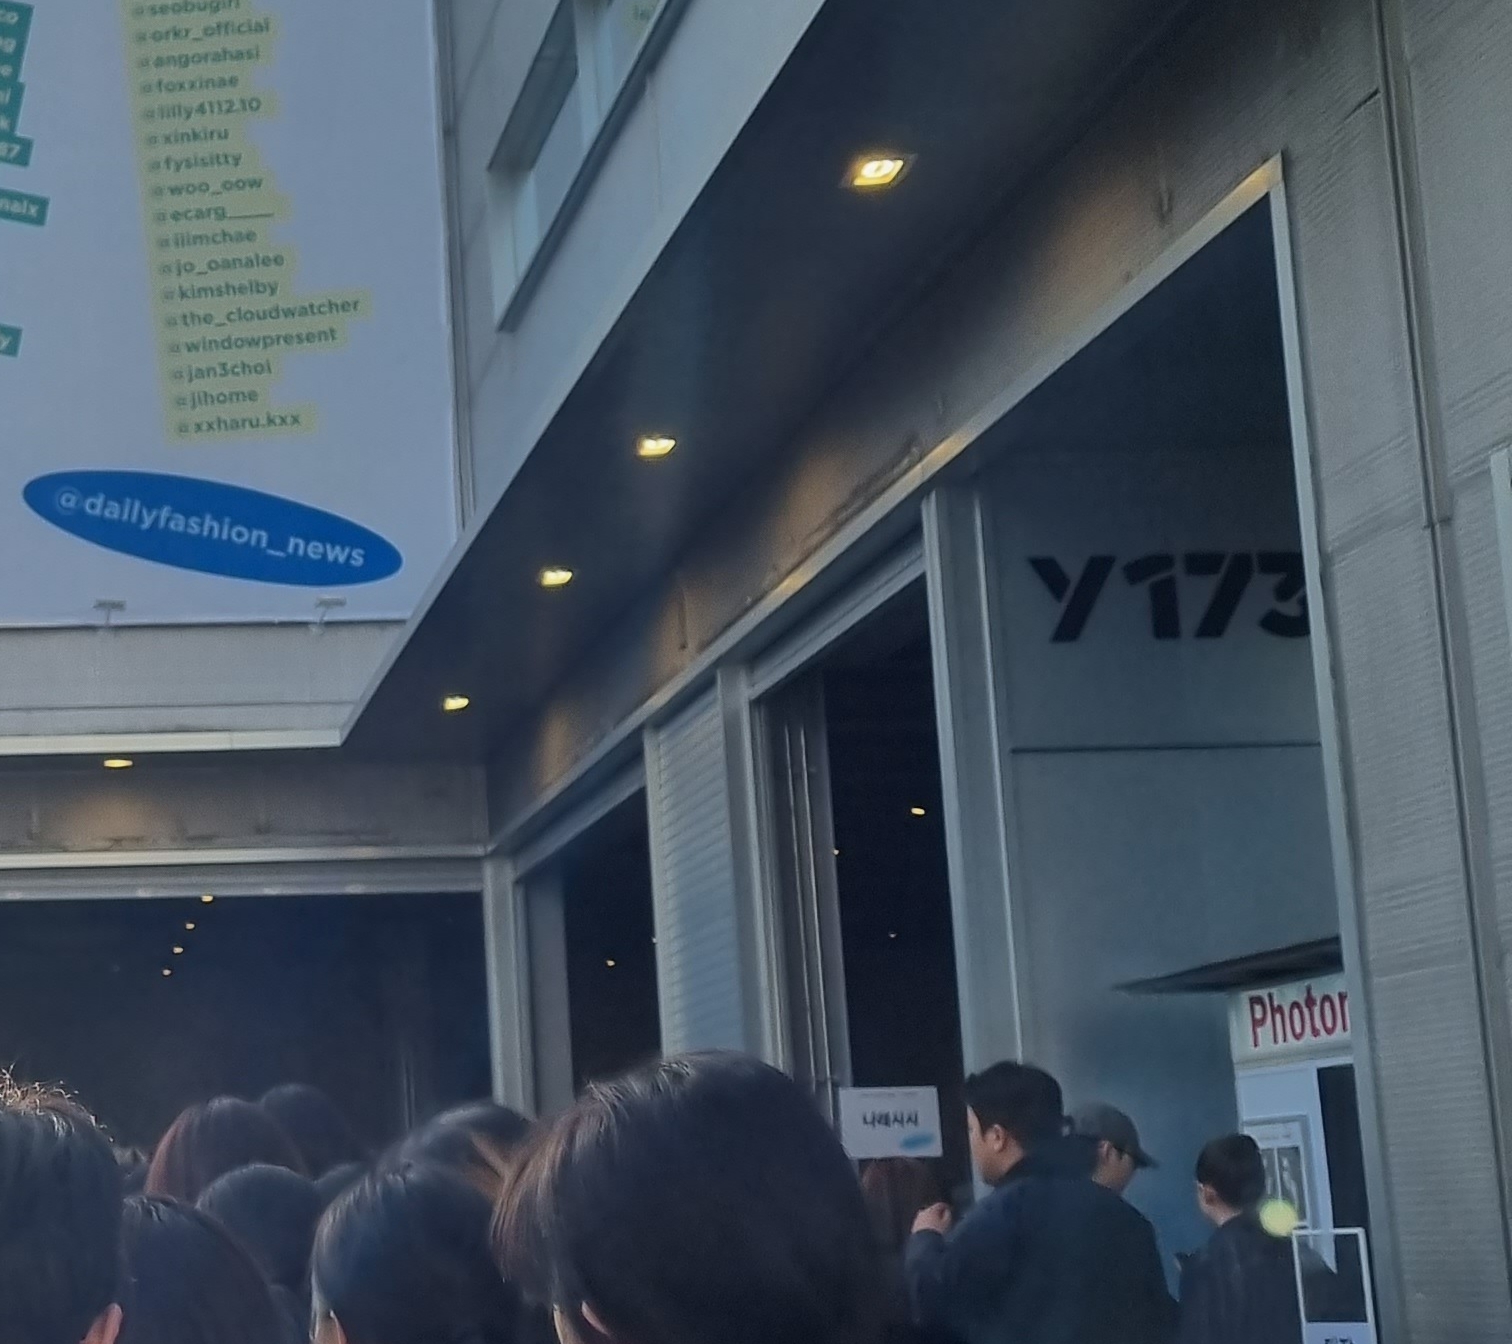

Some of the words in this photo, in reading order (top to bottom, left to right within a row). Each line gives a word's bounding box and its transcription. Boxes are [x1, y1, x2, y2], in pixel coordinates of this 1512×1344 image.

[164, 298, 361, 328] @the_cloudwatcher
[167, 327, 338, 354] @windowpresent
[56, 487, 365, 568] @dailyfashion_news
